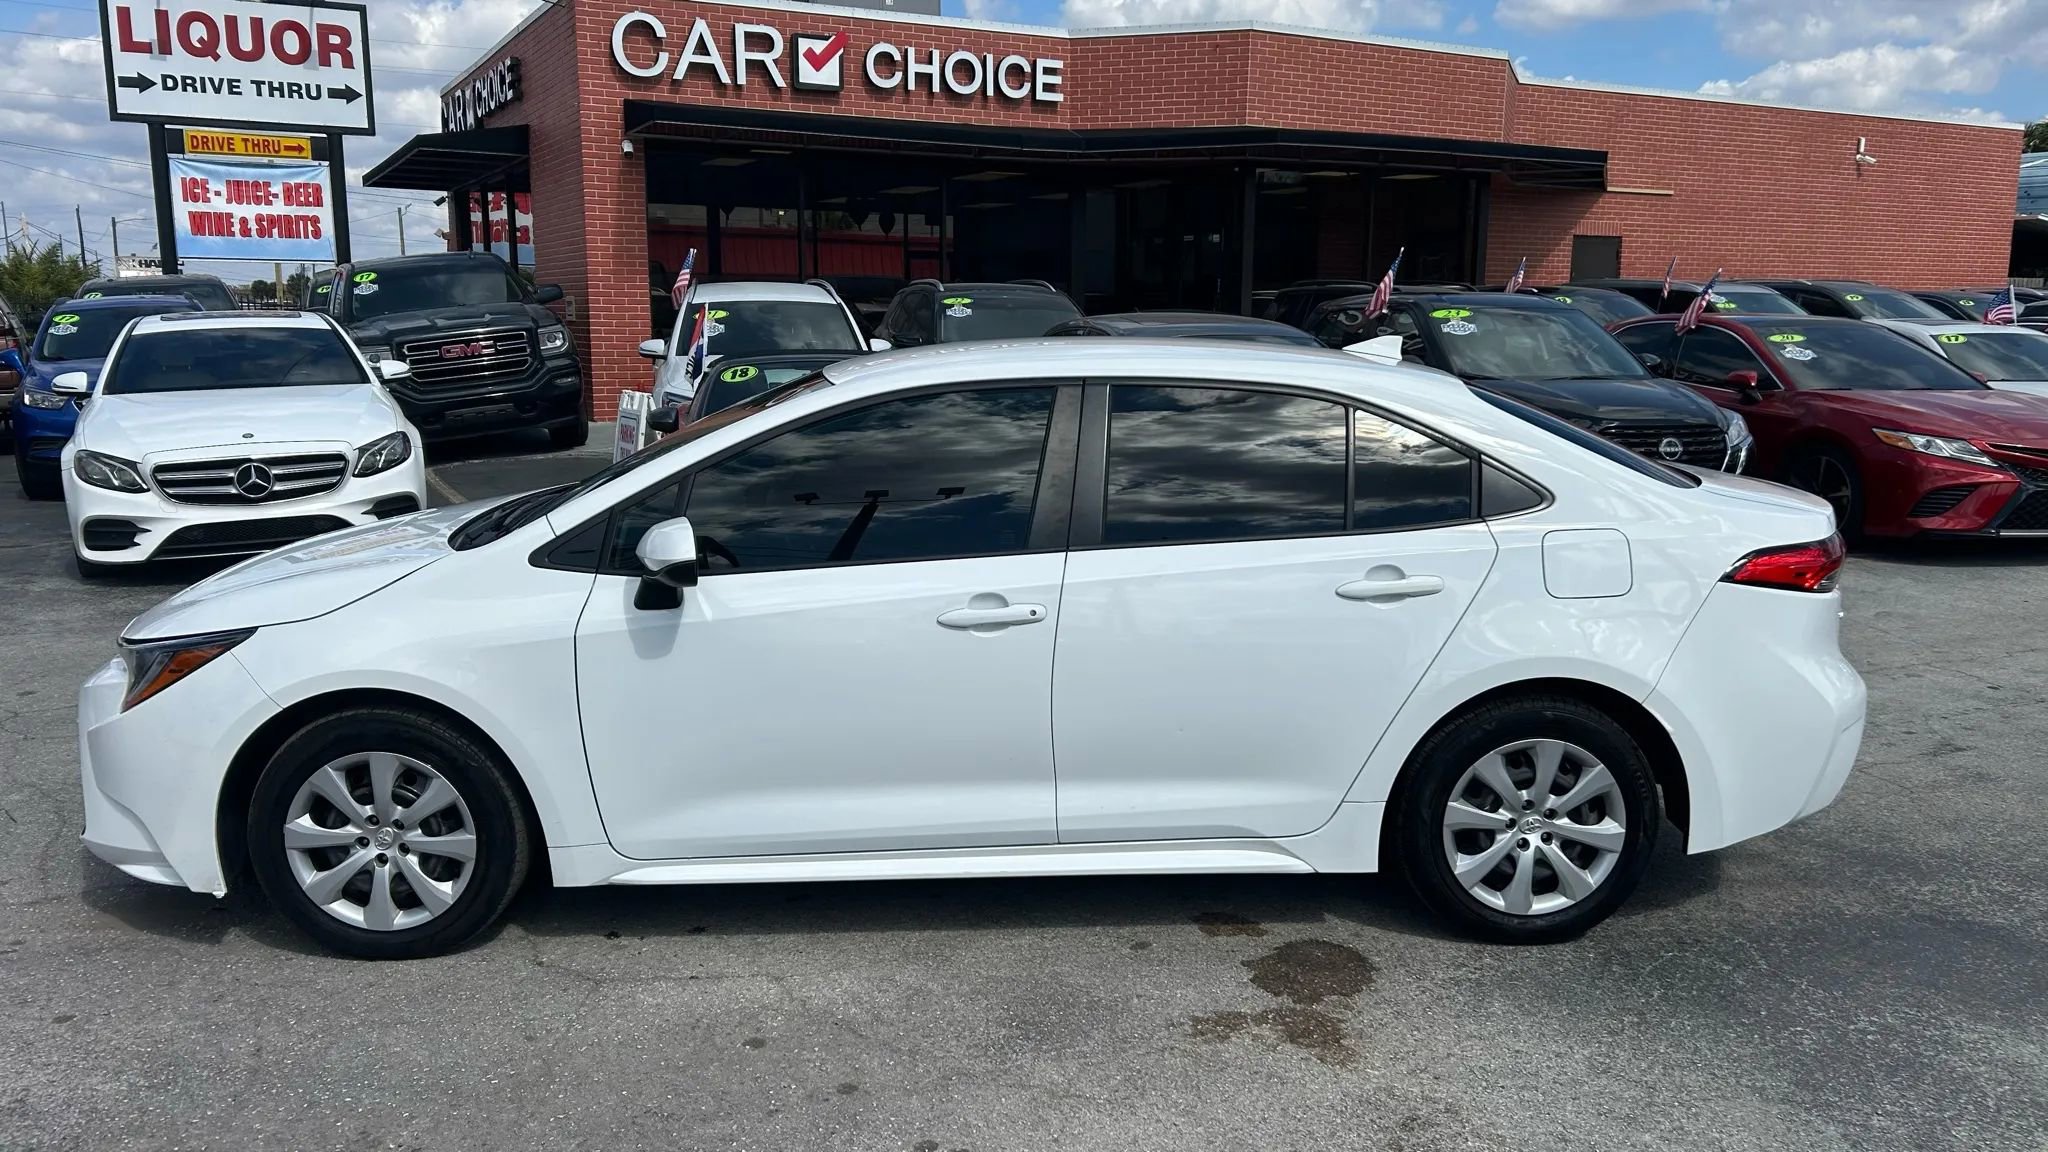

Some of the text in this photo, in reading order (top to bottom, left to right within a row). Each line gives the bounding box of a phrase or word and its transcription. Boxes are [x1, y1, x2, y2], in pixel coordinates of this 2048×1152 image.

[116, 5, 356, 70] LIQUOR
[611, 10, 1064, 102] CAR CHOICE
[160, 73, 322, 101] DRIVE THRU
[475, 57, 514, 118] CHOICE
[190, 134, 282, 154] DRIVE THRU
[180, 176, 211, 204] ICE
[281, 181, 324, 208] BEER
[187, 210, 322, 240] WINE & SPIRITS
[441, 340, 496, 359] GMC
[730, 366, 750, 380] 18
